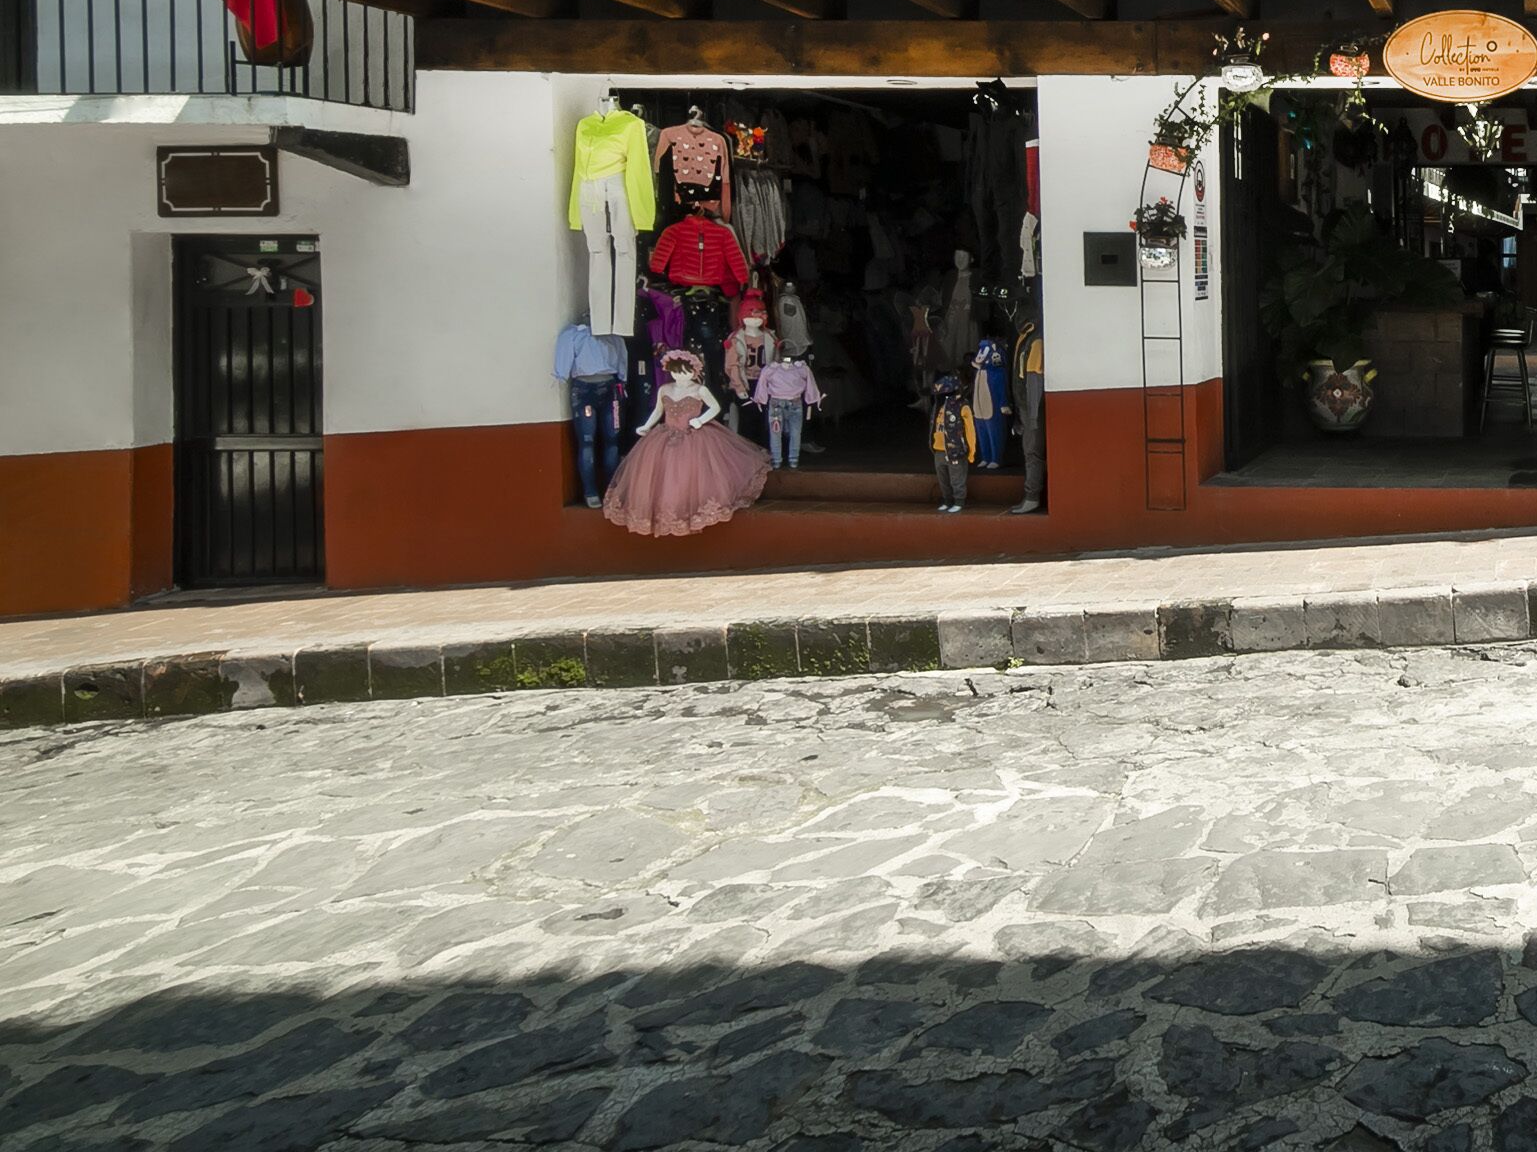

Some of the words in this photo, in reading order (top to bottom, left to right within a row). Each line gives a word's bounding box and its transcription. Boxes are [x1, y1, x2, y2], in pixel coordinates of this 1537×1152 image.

[1420, 31, 1491, 76] Collection
[1422, 76, 1456, 87] VALLE
[1458, 76, 1500, 87] BONITO
